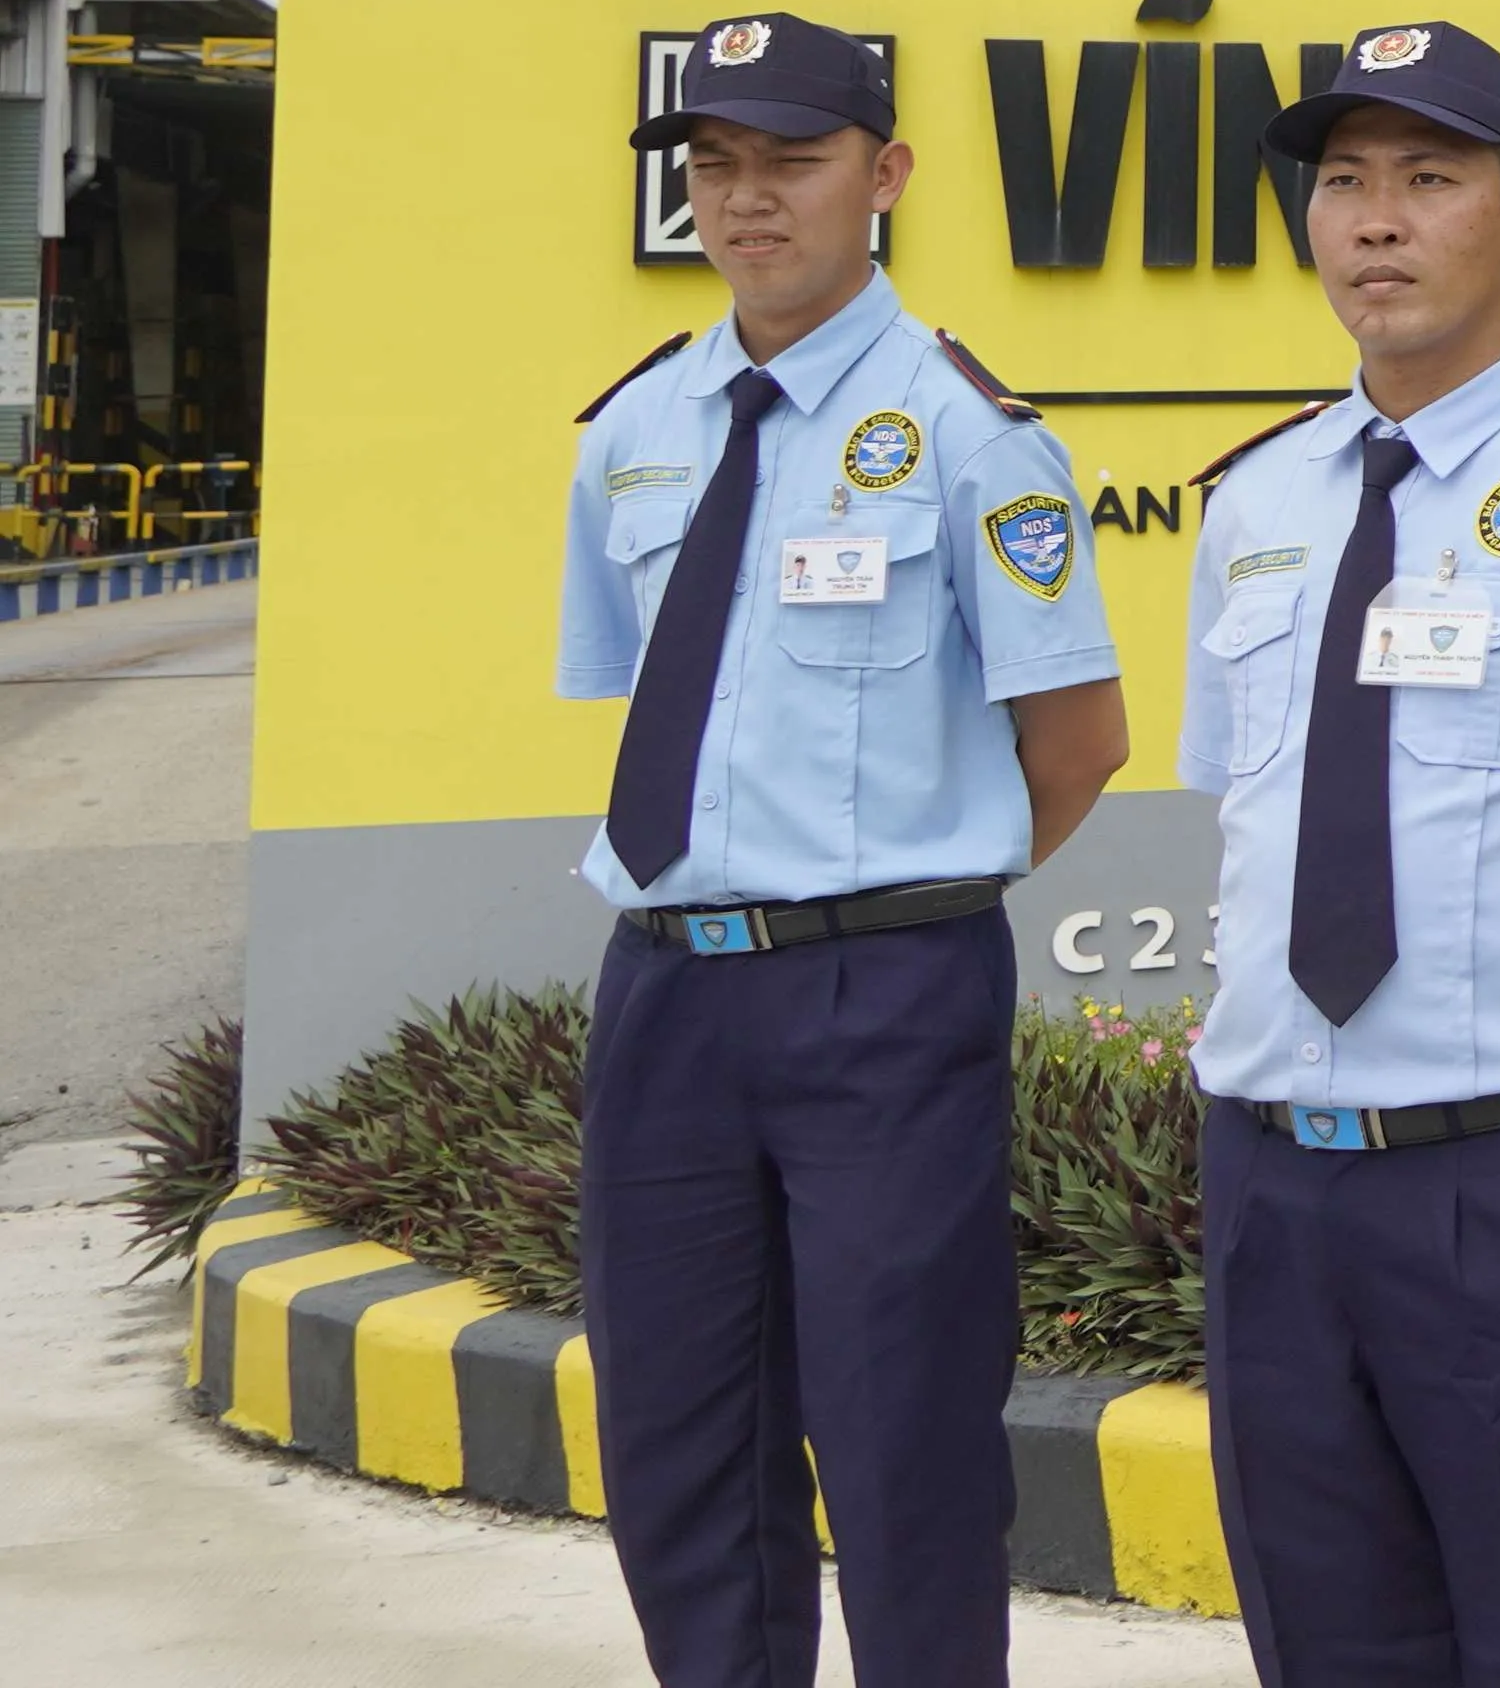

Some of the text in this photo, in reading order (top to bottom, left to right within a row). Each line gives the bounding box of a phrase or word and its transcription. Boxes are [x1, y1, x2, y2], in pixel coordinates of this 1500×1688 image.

[872, 430, 898, 442] NDS
[996, 496, 1065, 524] SECURITY
[1020, 516, 1053, 537] NDS
